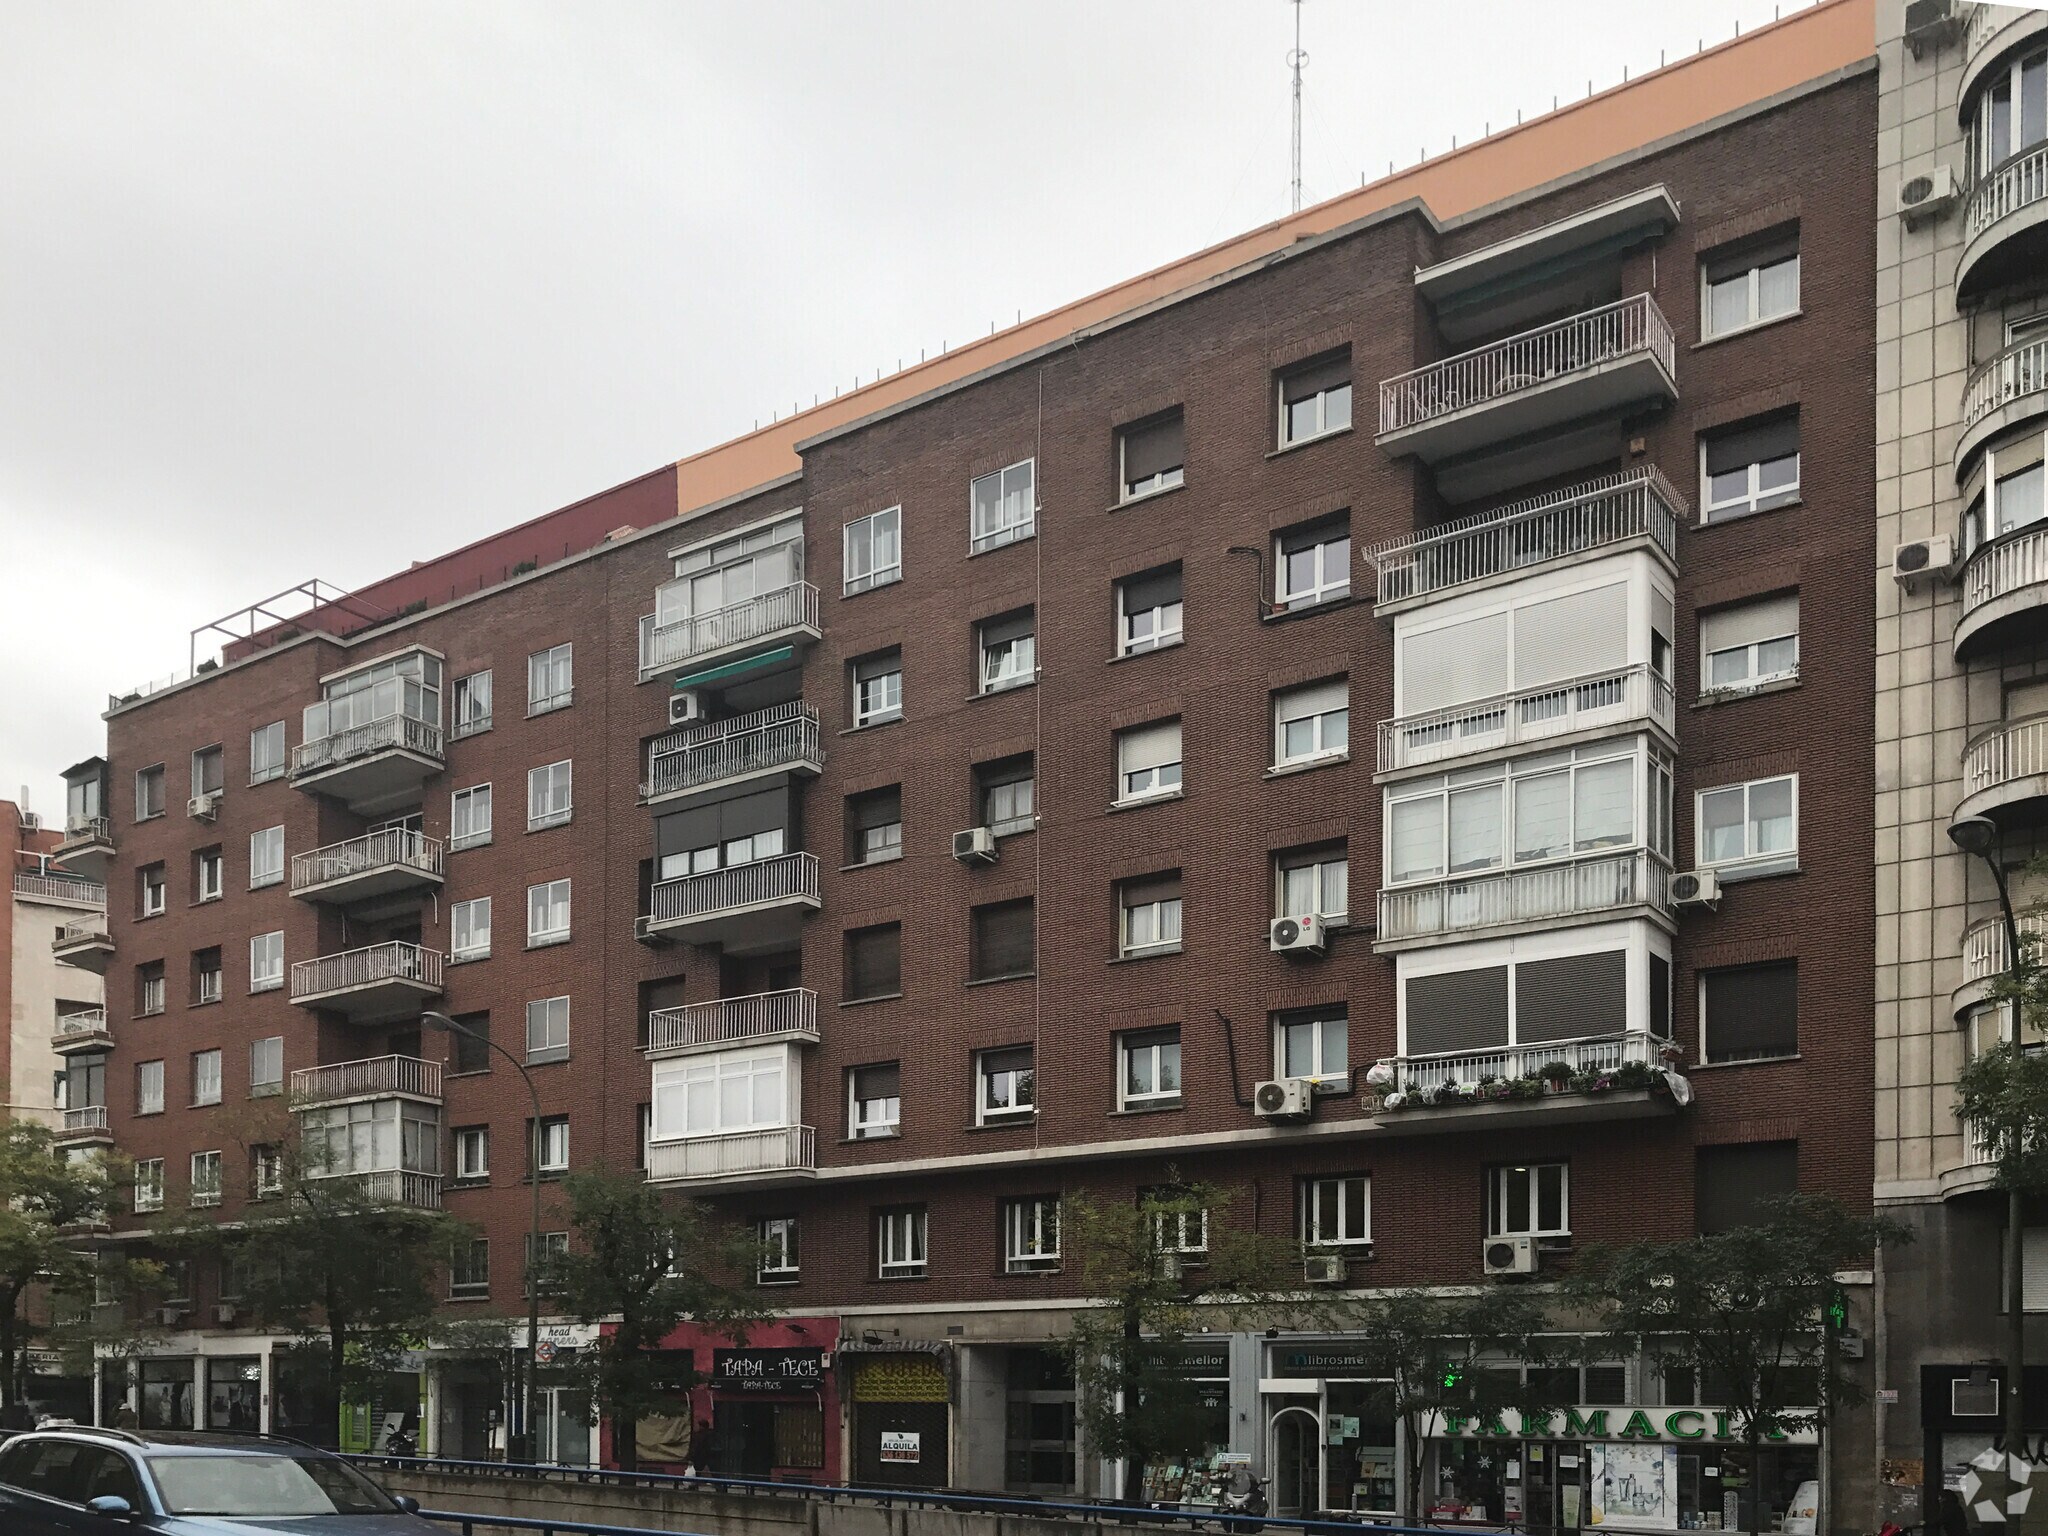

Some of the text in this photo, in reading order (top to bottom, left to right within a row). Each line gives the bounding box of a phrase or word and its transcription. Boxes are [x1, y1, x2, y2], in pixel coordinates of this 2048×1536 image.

[548, 1326, 571, 1337] head
[1308, 1355, 1374, 1365] librosme
[722, 1357, 764, 1376] TAPA
[779, 1357, 819, 1376] TECE
[883, 1442, 918, 1450] ALQUILA
